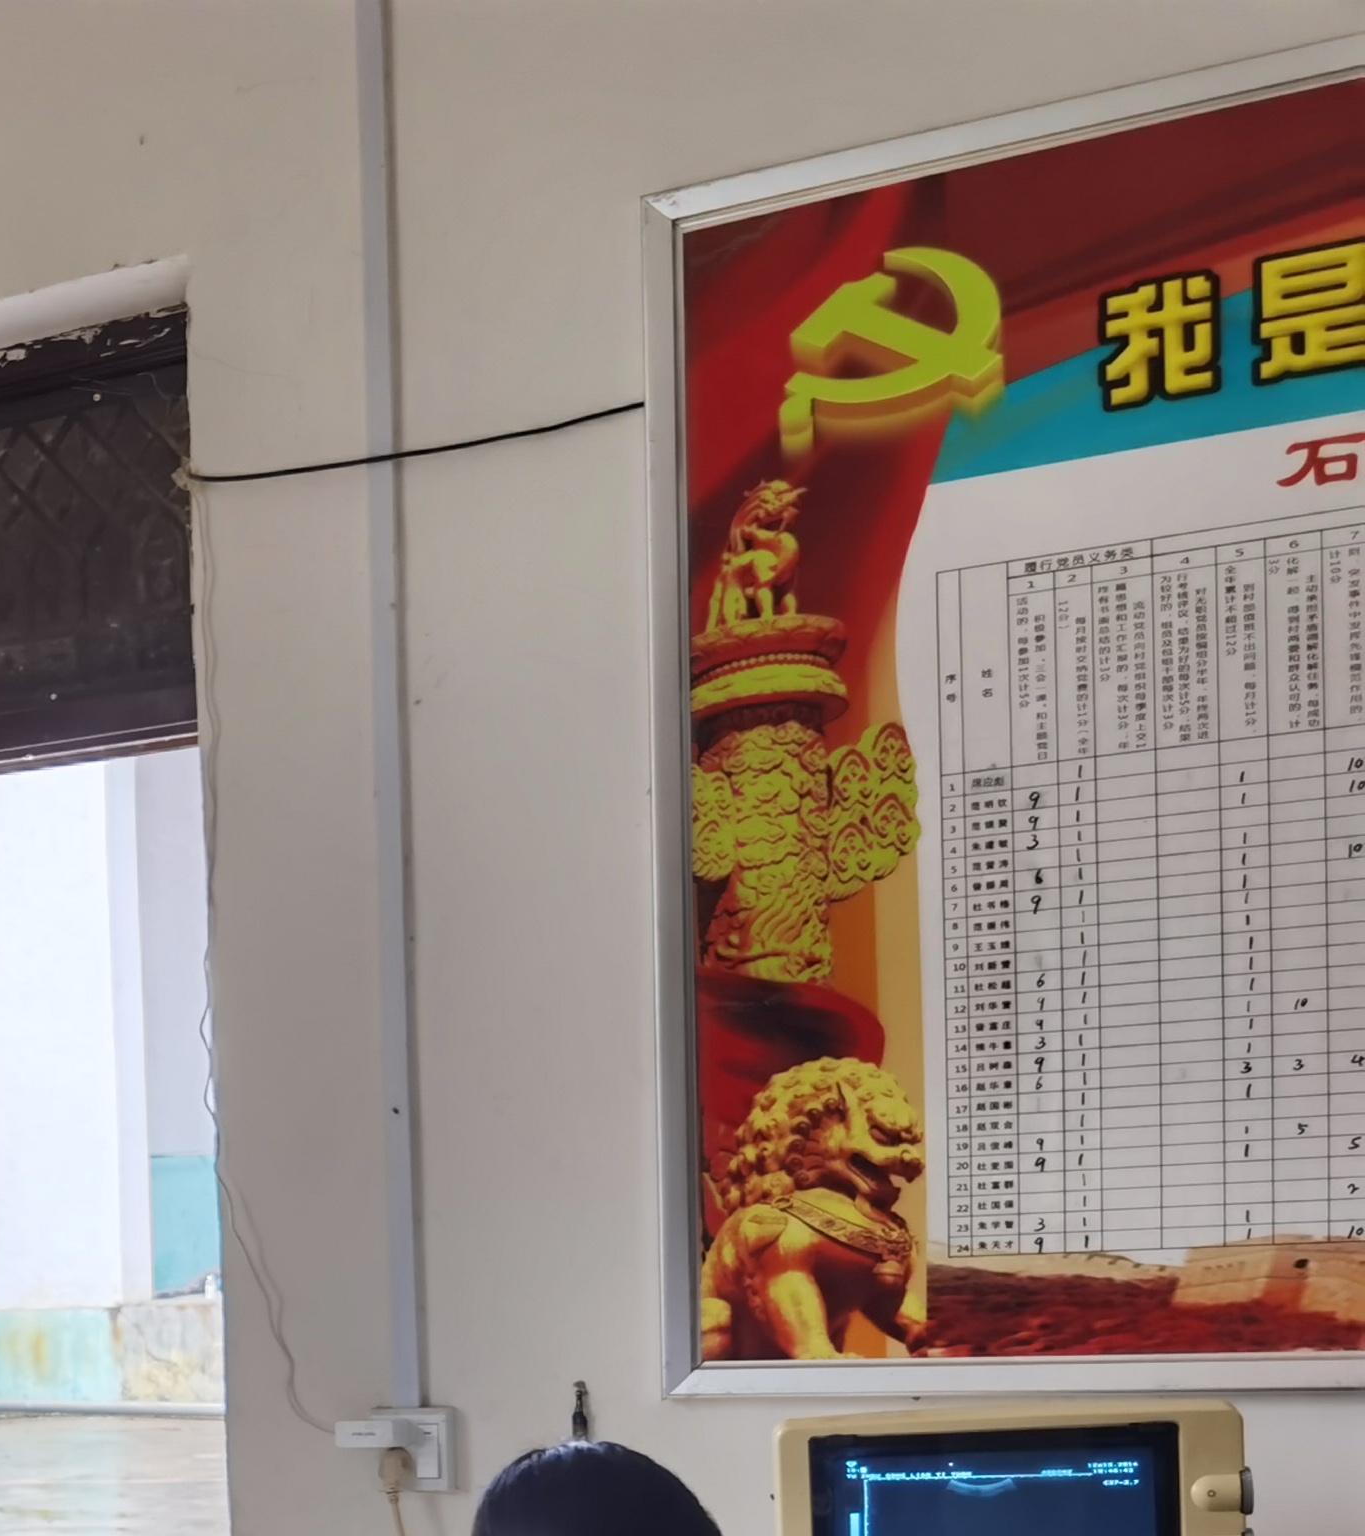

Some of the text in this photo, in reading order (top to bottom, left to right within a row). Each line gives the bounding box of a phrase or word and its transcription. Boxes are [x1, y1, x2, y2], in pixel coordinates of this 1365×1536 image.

[1023, 546, 1135, 575] 履行党员义务类
